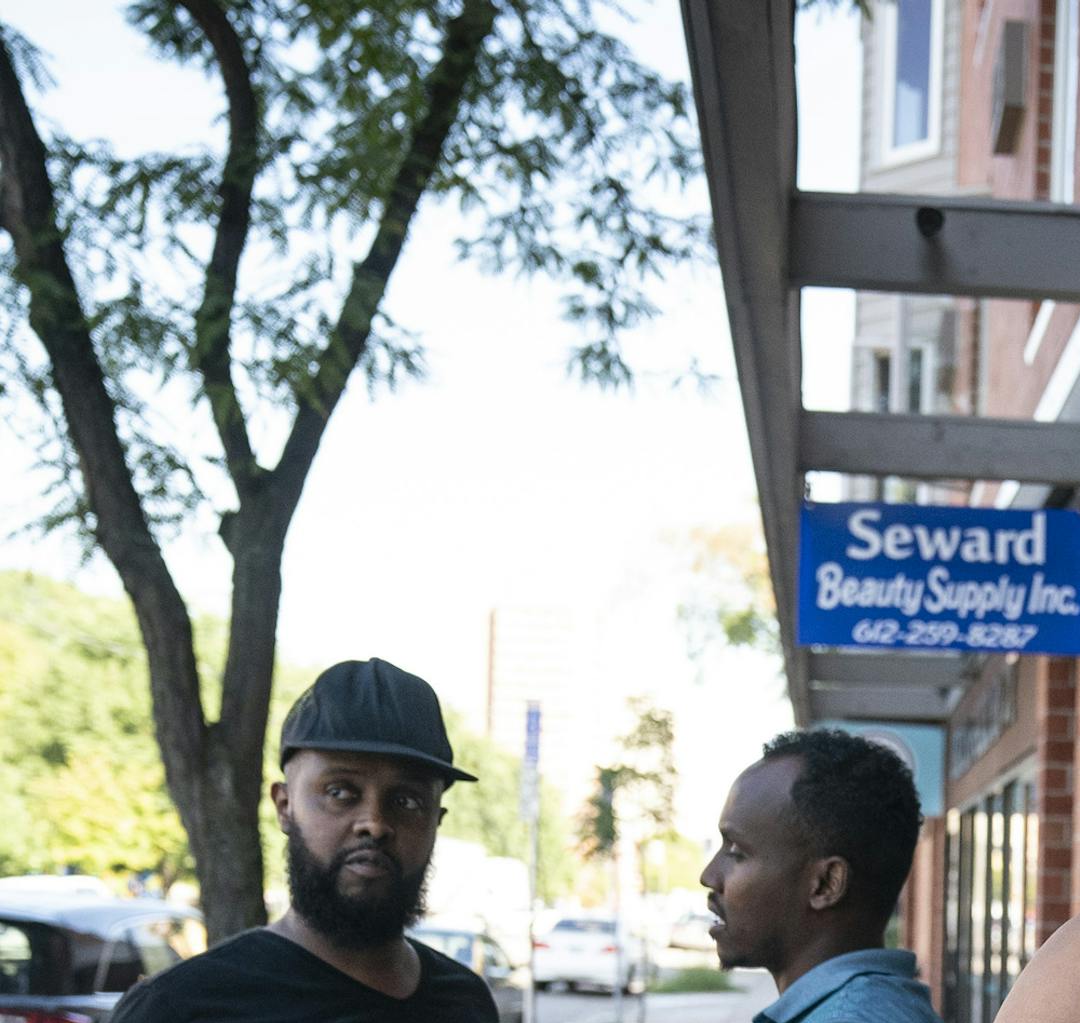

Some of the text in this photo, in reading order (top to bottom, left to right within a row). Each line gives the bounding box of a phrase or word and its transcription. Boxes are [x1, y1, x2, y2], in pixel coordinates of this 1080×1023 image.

[846, 509, 1046, 565] Seward
[816, 561, 1080, 620] Beauty Supply Inc.
